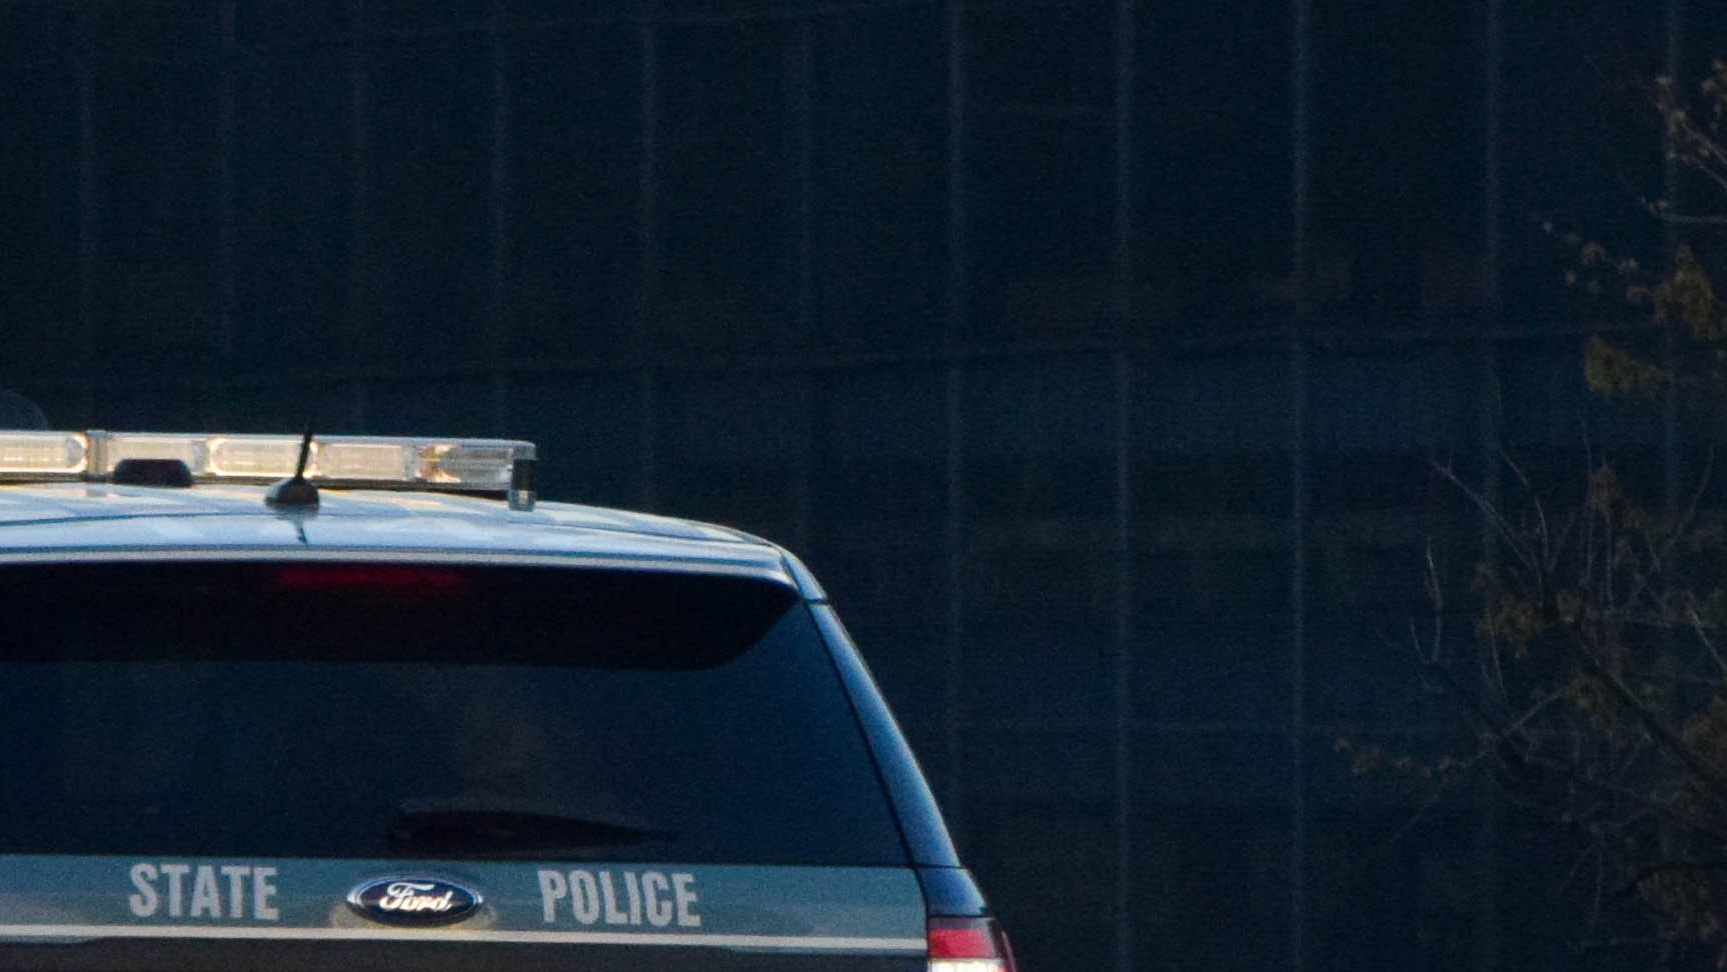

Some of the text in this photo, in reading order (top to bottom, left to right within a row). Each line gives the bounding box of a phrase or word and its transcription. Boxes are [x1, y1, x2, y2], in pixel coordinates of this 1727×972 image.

[129, 862, 702, 928] STATE POLICE
[378, 881, 454, 914] Ford
